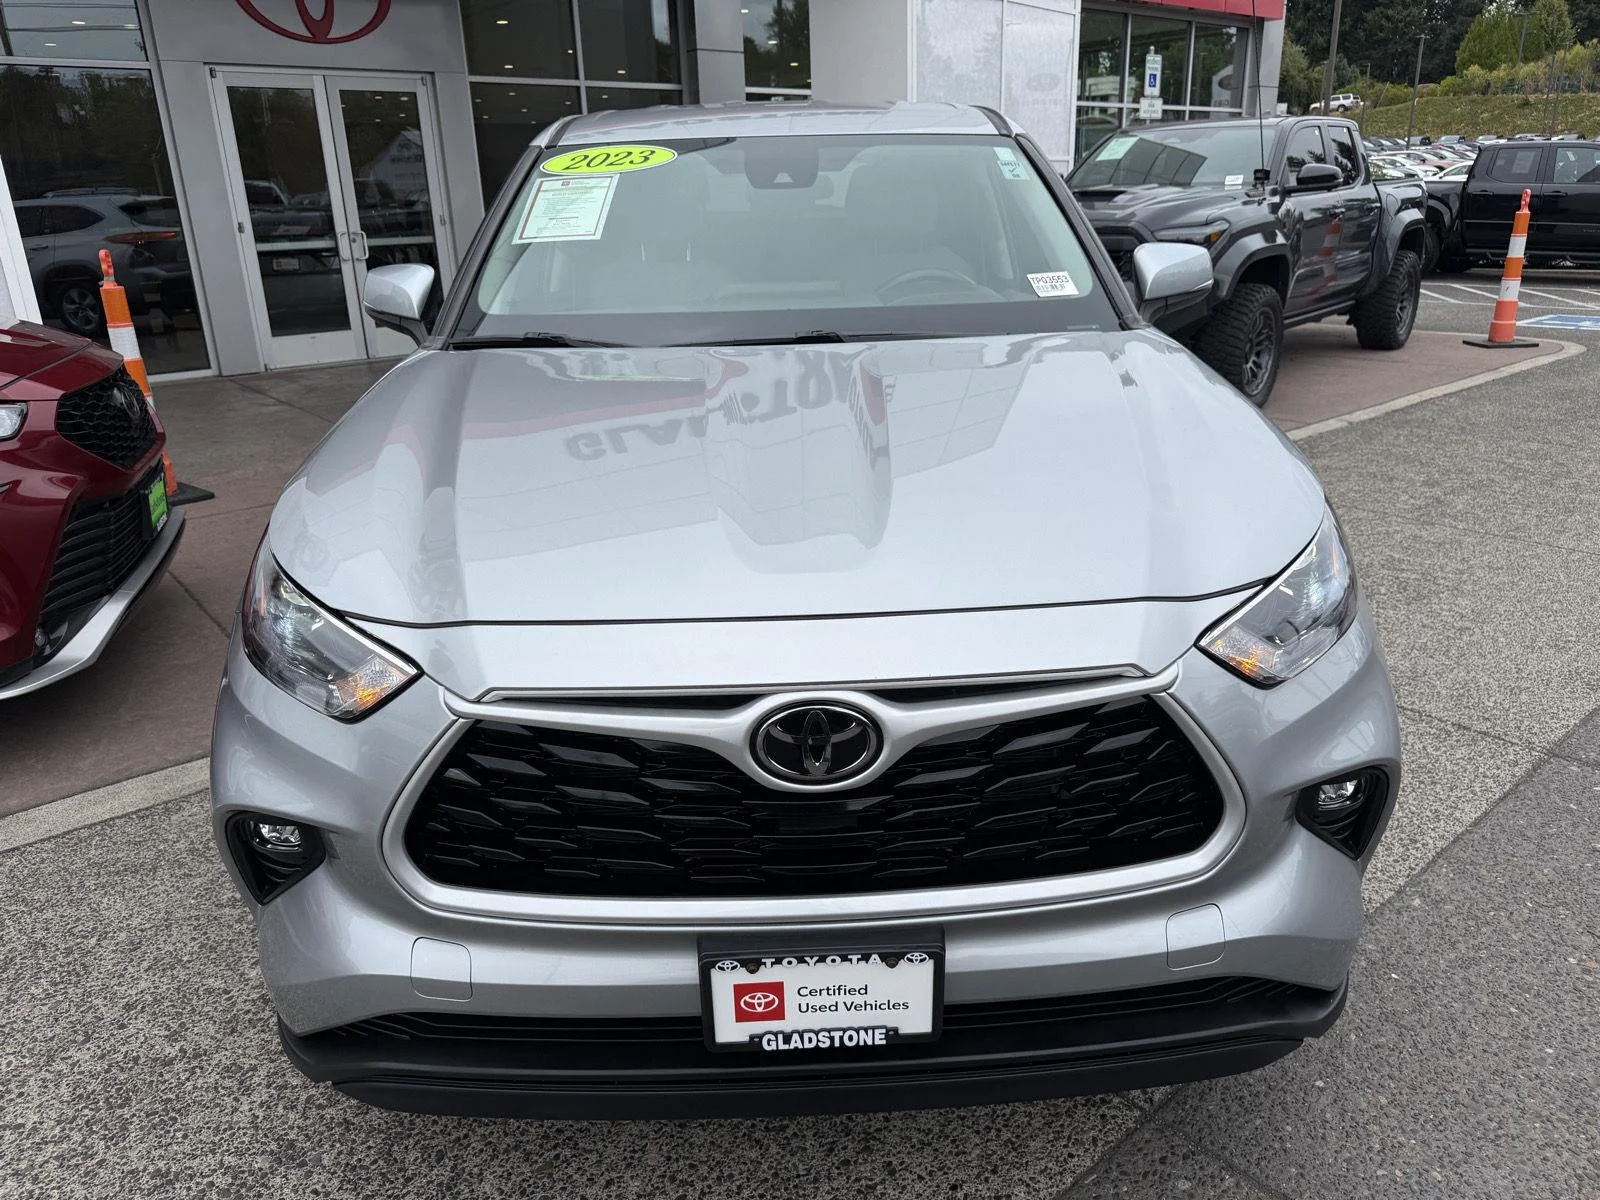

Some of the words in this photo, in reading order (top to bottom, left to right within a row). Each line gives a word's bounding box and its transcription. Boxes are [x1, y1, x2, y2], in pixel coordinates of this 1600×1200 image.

[562, 149, 656, 171] 2023
[761, 953, 883, 968] TOYOTA
[797, 984, 868, 998] Certified
[798, 1002, 839, 1013] Used
[843, 999, 910, 1013] Vehicles
[761, 1028, 887, 1050] GLADSTONE
